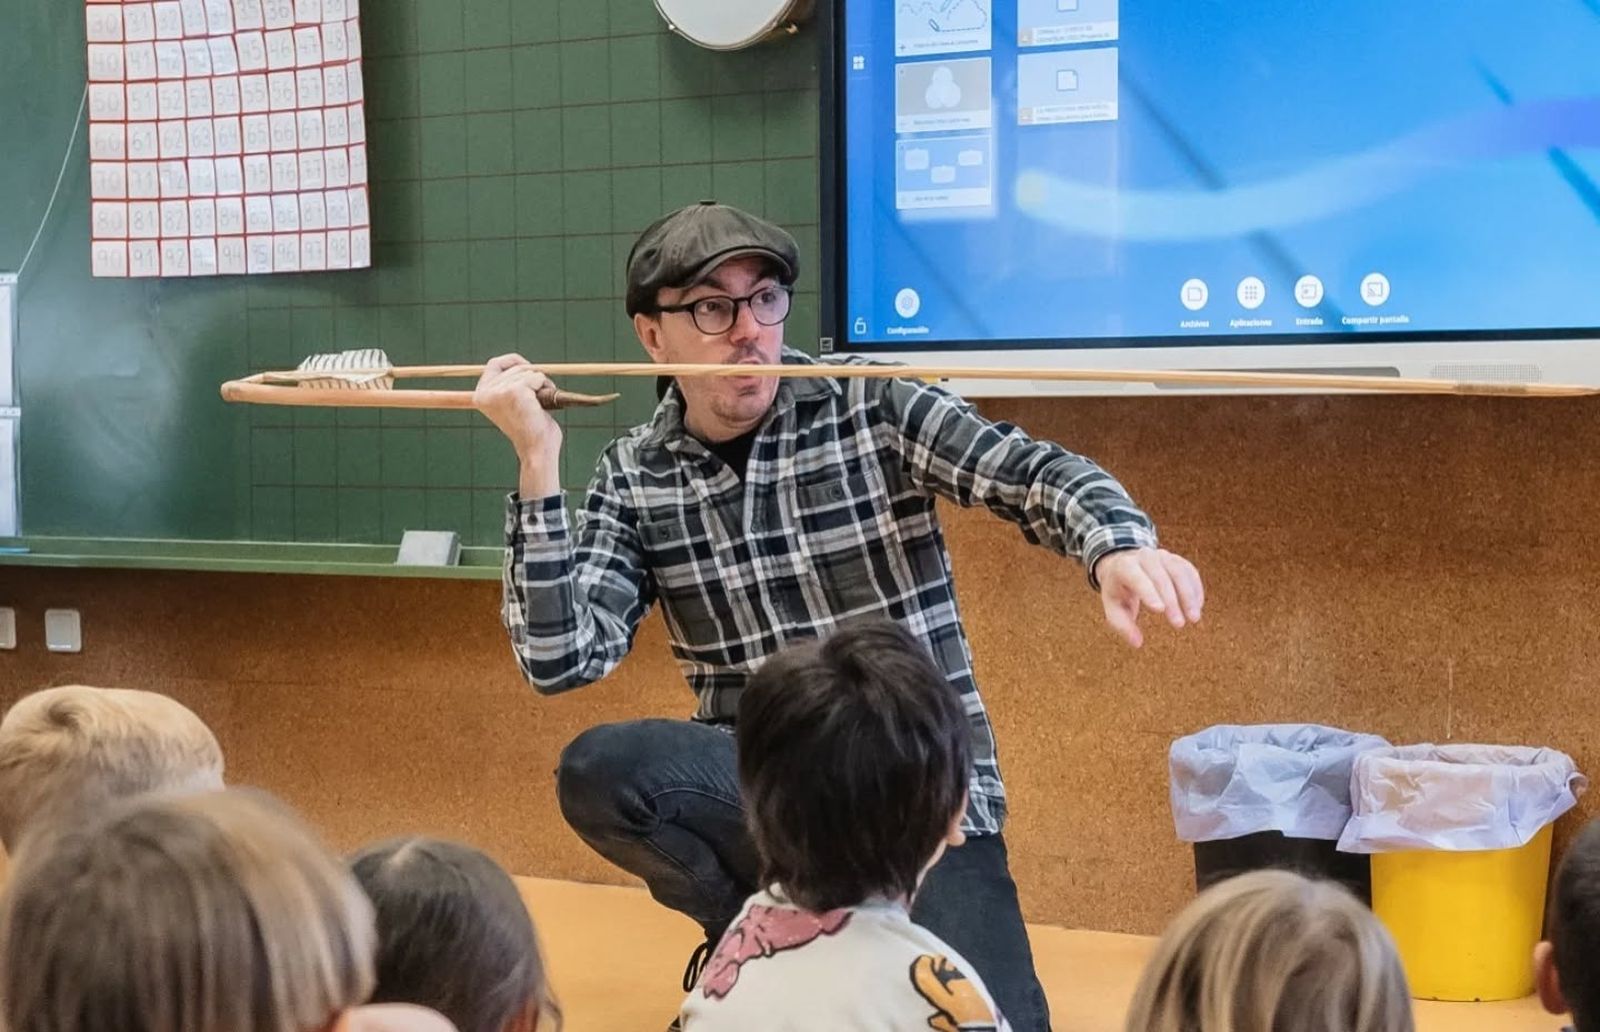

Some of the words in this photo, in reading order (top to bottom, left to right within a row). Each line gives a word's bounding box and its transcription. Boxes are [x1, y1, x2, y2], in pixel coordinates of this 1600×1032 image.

[94, 91, 120, 112] 50
[132, 90, 151, 111] 51
[132, 131, 151, 151] 61
[134, 209, 153, 231] 81
[133, 247, 153, 267] 91
[222, 245, 241, 265] 94
[1230, 319, 1272, 328] Aplicaciones
[1296, 317, 1323, 325] Entrada
[1342, 316, 1378, 325] Compartir
[1380, 315, 1409, 324] pantalla
